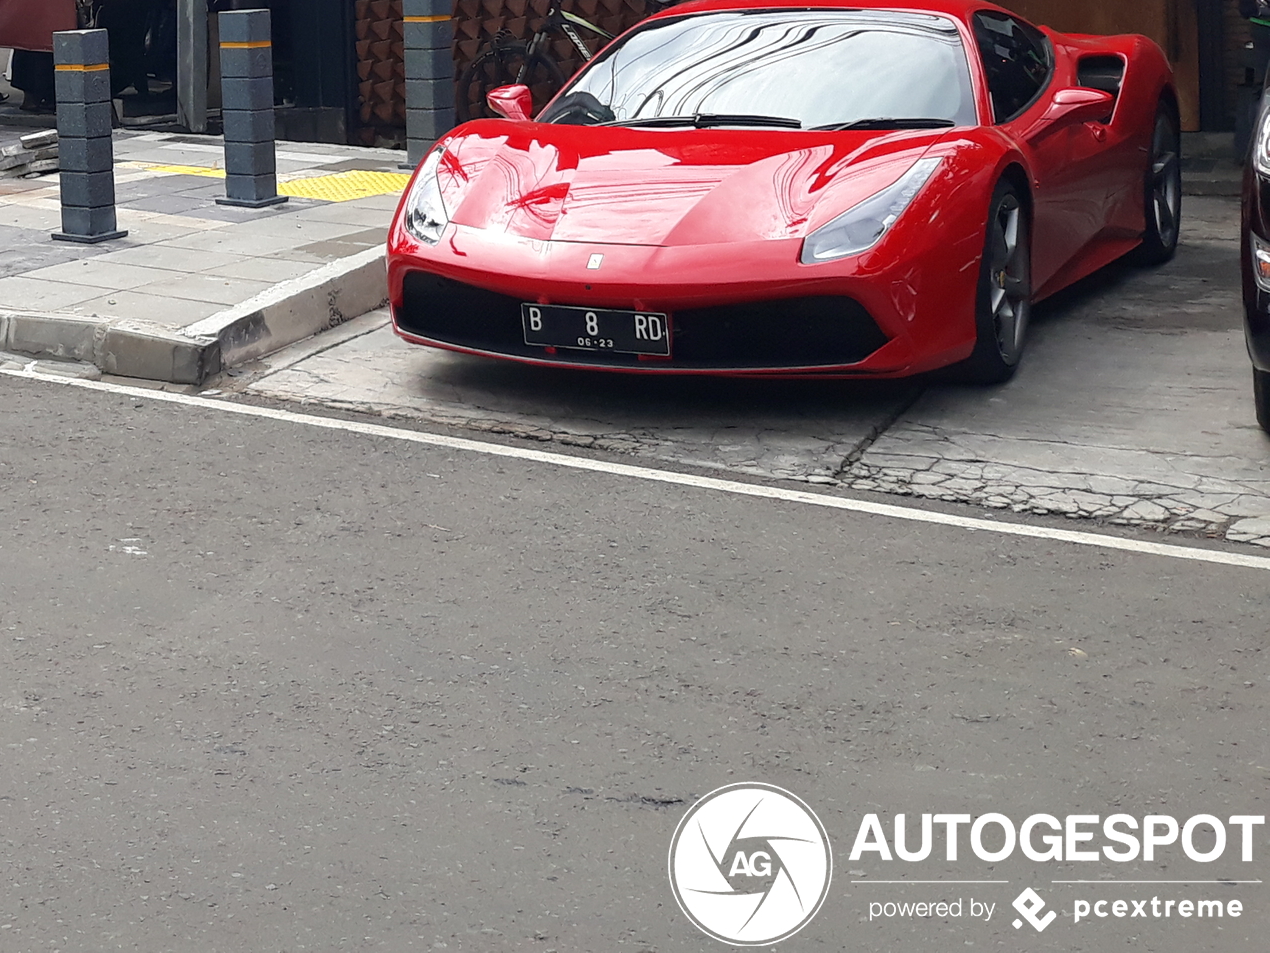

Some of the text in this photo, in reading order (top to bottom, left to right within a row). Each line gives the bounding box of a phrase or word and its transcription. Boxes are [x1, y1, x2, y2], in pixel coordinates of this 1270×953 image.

[561, 23, 591, 61] LAPIE
[529, 307, 662, 341] B 8 RD
